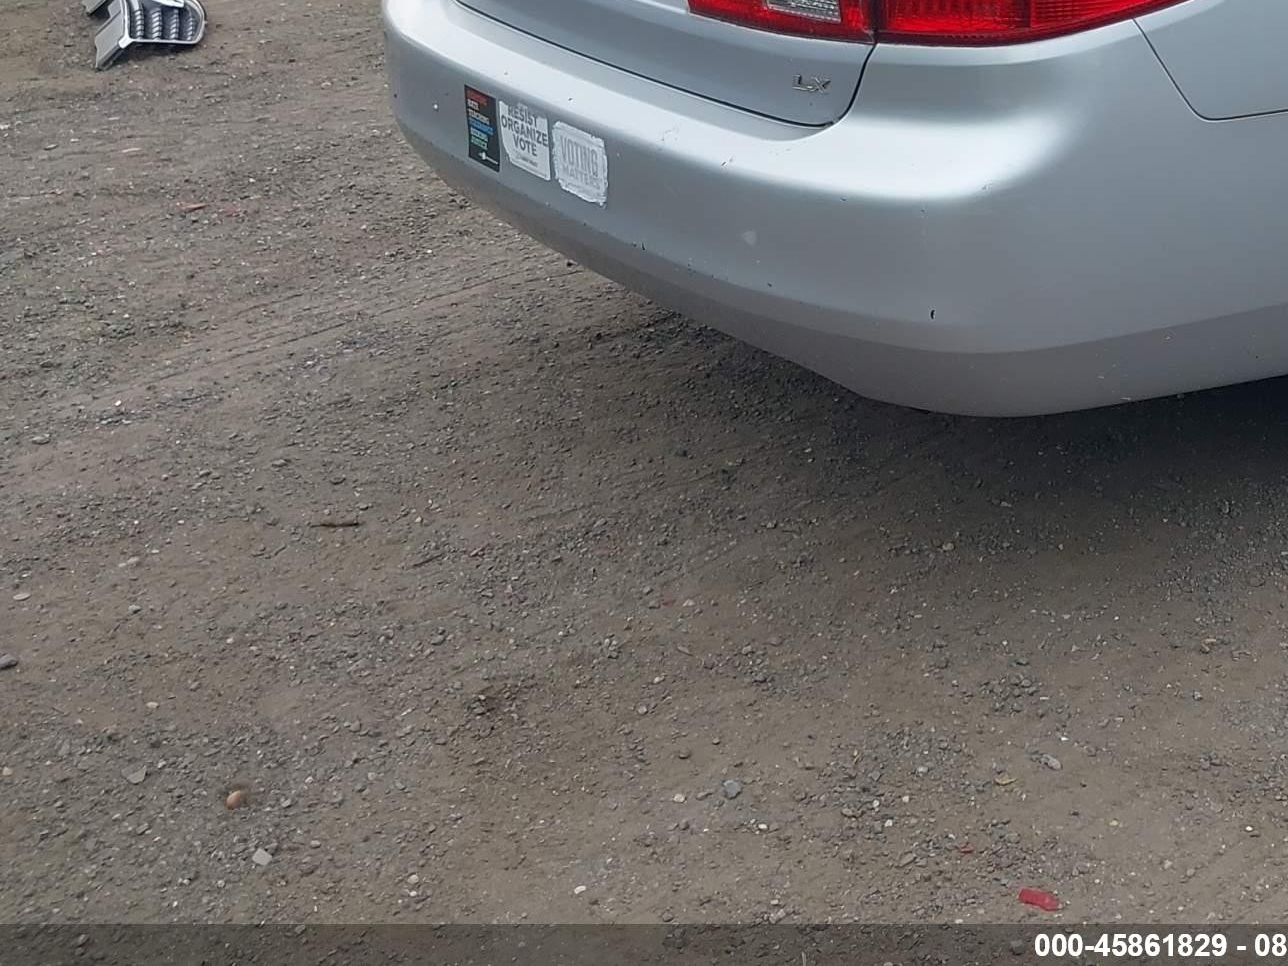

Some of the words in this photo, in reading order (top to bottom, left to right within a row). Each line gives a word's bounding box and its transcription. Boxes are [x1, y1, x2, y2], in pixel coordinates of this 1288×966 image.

[791, 73, 832, 95] LX
[507, 101, 540, 129] RESIST
[500, 113, 549, 148] ORGANIZE
[512, 132, 539, 157] VOTE
[560, 135, 599, 179] VOTING
